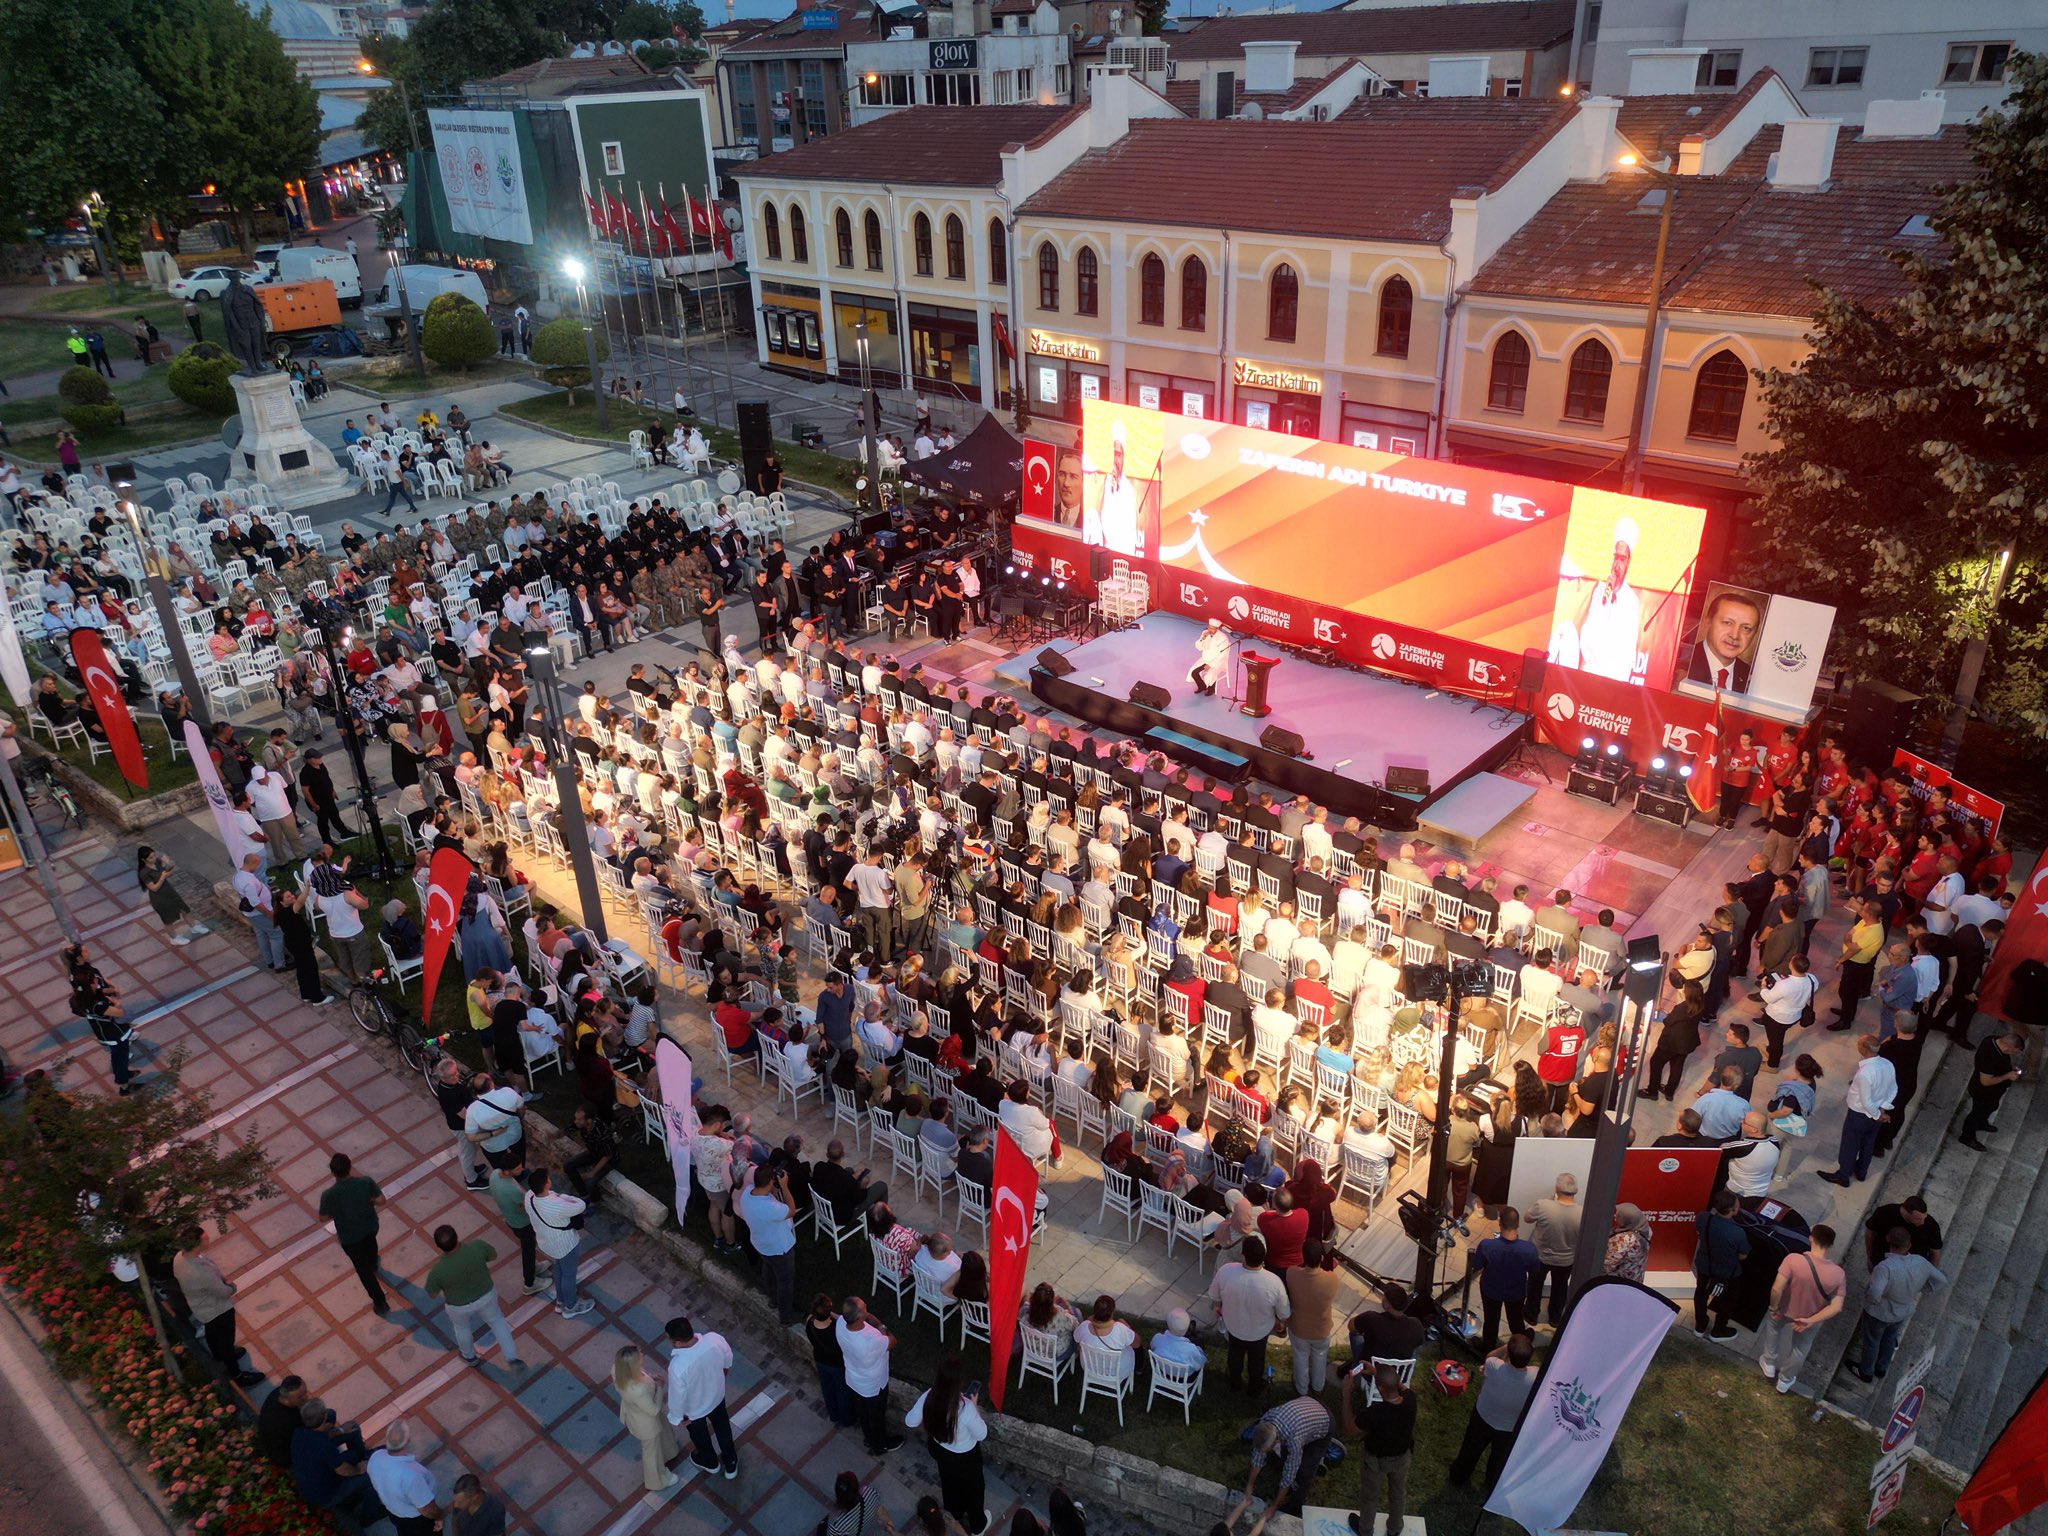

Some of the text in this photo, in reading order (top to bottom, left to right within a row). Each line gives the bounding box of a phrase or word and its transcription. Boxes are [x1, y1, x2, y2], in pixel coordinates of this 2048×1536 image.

[934, 43, 972, 68] glory
[1041, 339, 1065, 356] Ziraat
[1246, 368, 1279, 388] Ziraat
[1328, 465, 1367, 487] ADI
[1279, 611, 1291, 621] ADI
[1431, 651, 1445, 661] ADI
[1615, 714, 1632, 726] ADI
[1658, 1214, 1697, 1223] Zaferi!
